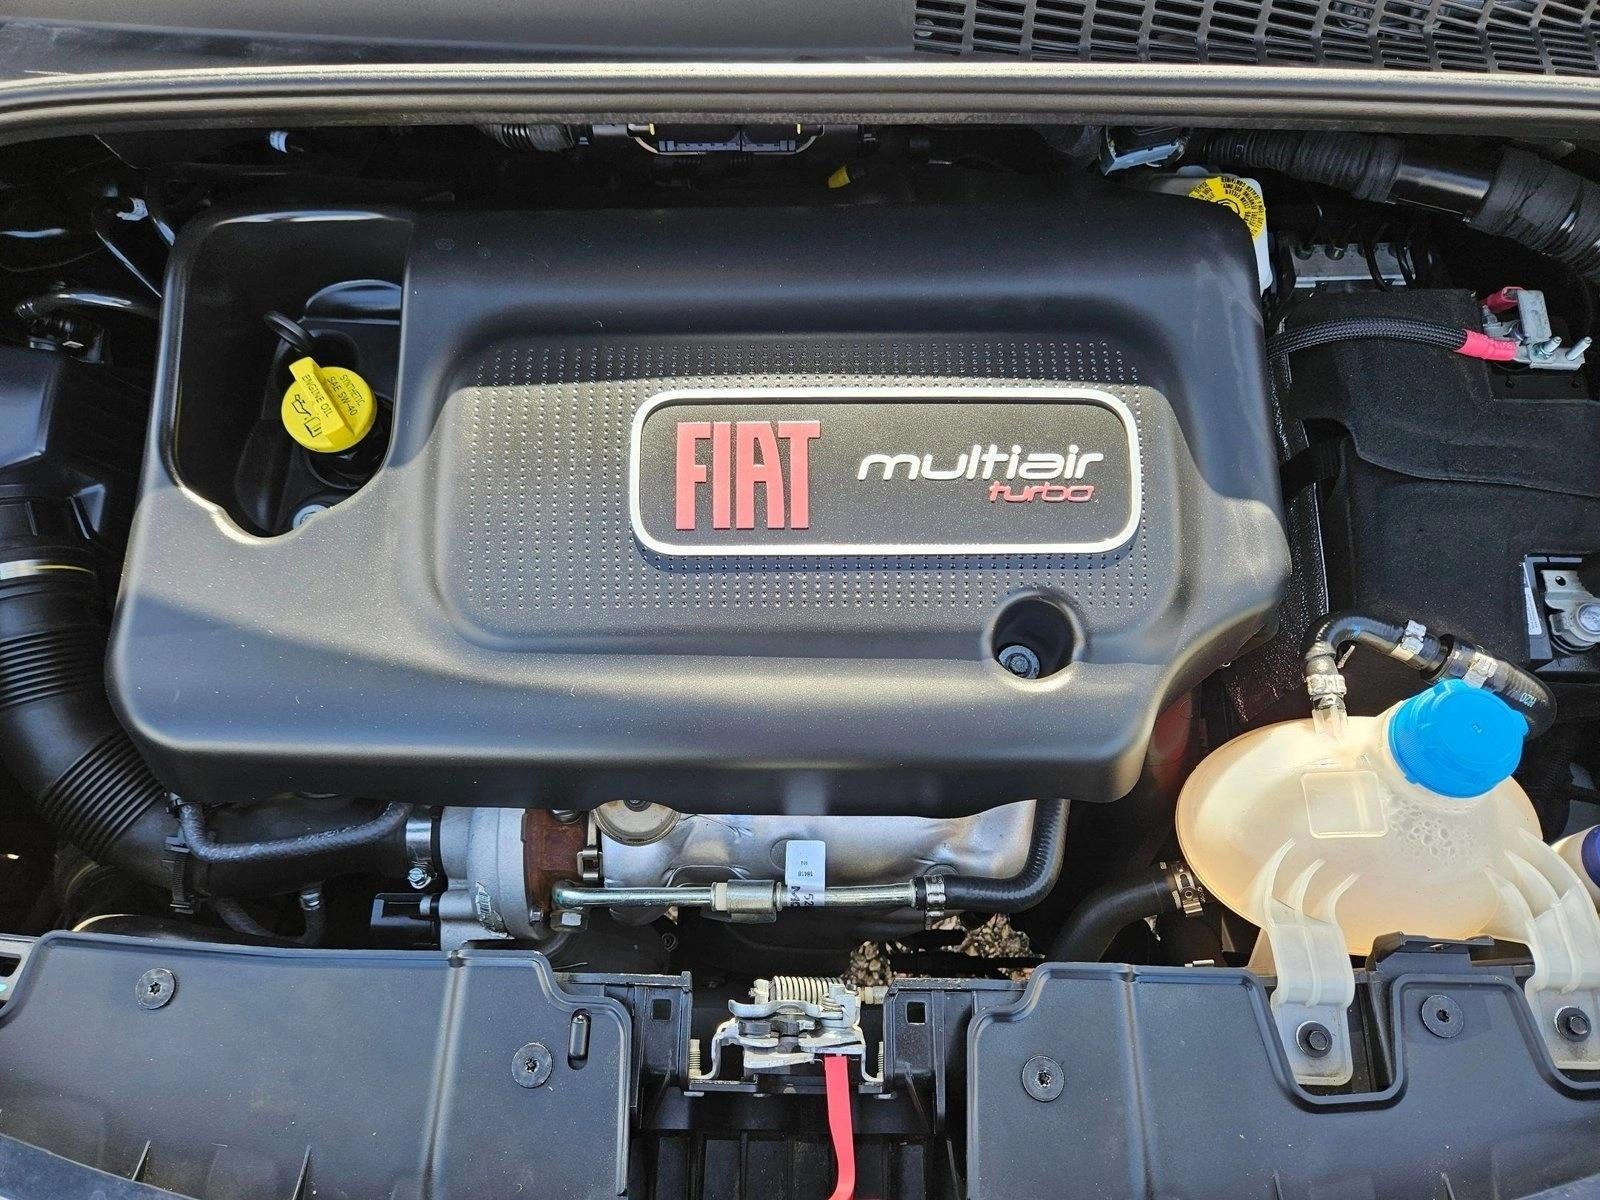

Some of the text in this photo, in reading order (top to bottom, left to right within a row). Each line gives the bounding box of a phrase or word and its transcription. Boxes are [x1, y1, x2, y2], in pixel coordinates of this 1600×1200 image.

[302, 374, 333, 418] ENGINE OIL
[327, 376, 358, 416] SAE 5W-40
[340, 374, 366, 407] SYNTHETIC
[675, 419, 821, 530] FIAT
[857, 444, 1105, 481] multiair
[988, 481, 1095, 503] turbo
